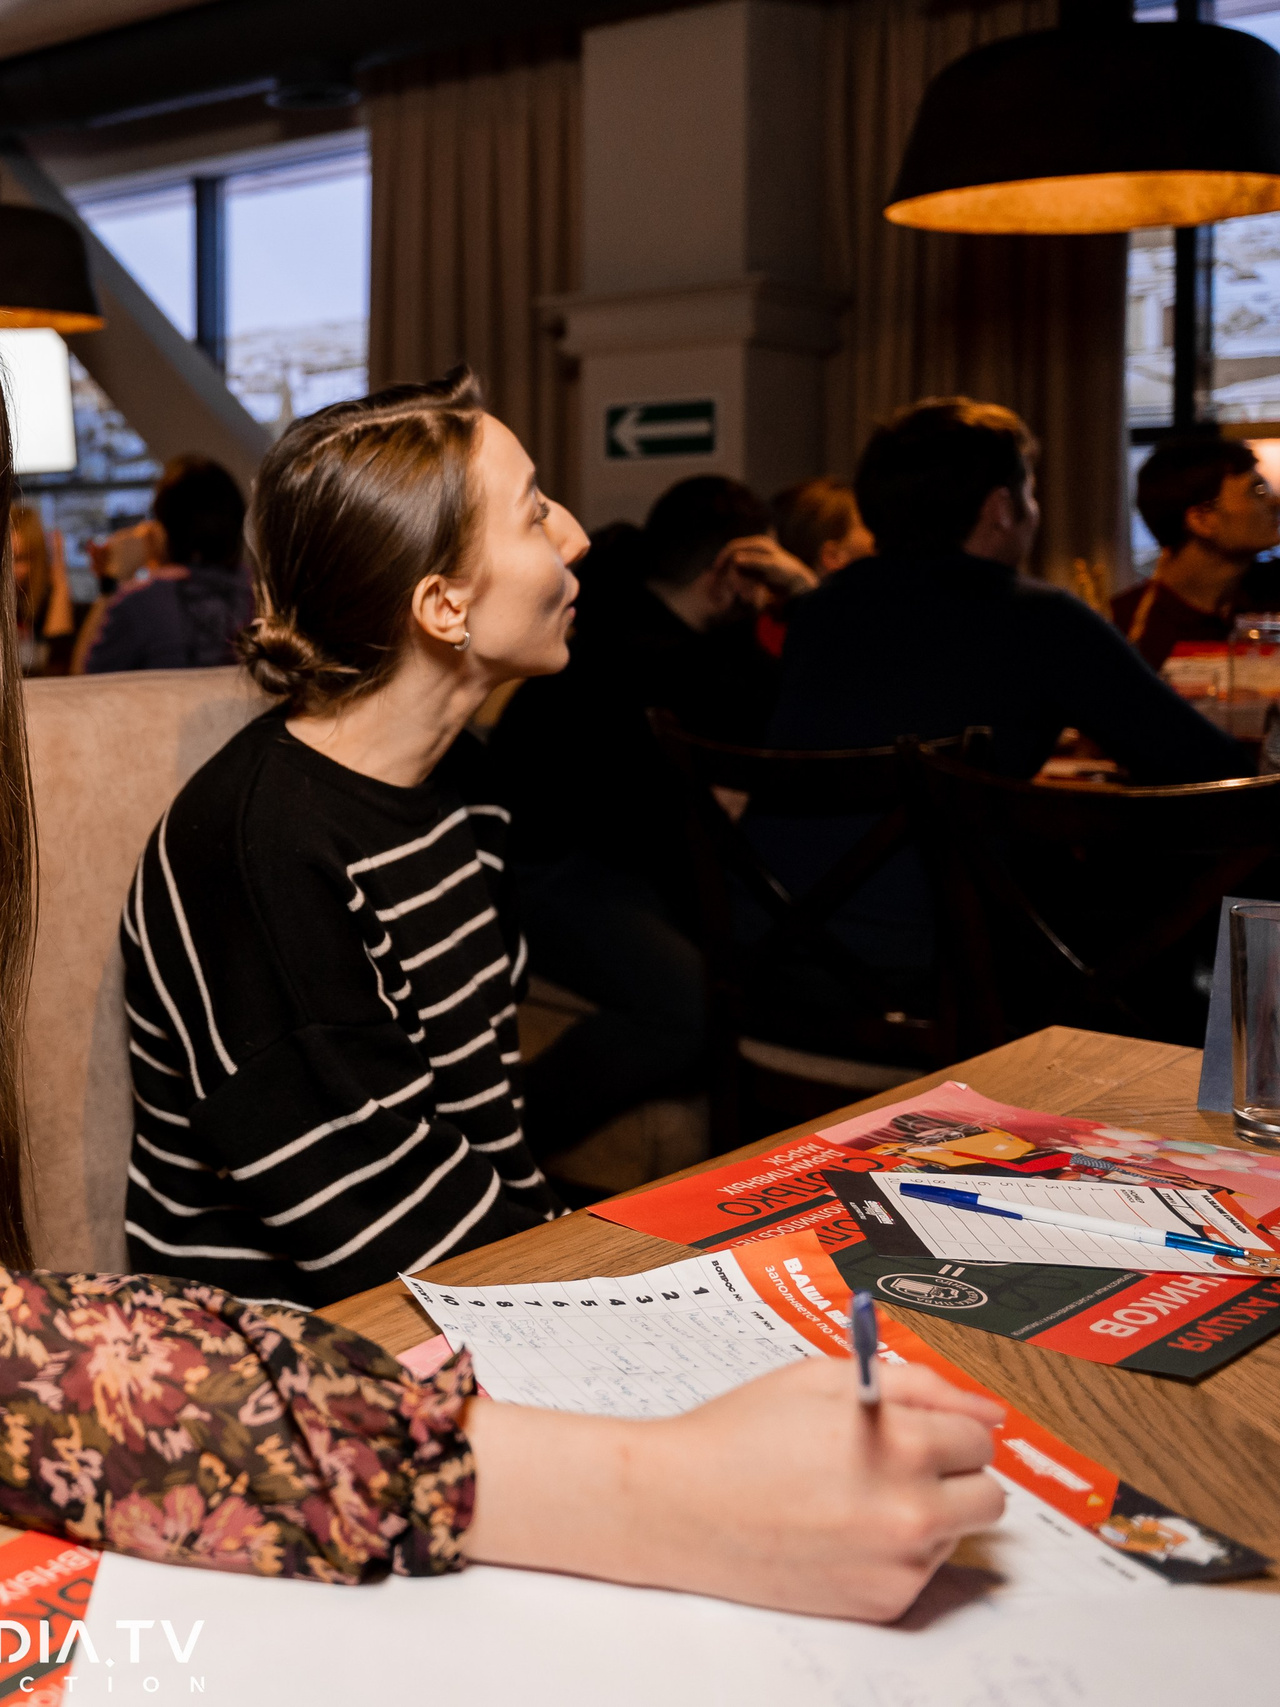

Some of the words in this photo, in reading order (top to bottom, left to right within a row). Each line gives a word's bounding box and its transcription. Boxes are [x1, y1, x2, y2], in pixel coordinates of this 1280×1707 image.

[763, 1142, 825, 1166] МАРОК
[787, 1148, 846, 1174] ДАРИМ
[716, 1168, 793, 1196] ПИВНЫХ
[717, 1157, 884, 1216] СОЛЬКО
[711, 1260, 736, 1293] ВОПРОС
[783, 1257, 832, 1311] ВАША
[439, 1293, 460, 1306] 10
[636, 1295, 653, 1304] 3
[661, 1291, 680, 1301] 2
[692, 1286, 710, 1296] 1
[496, 1300, 514, 1308] 8
[580, 1299, 599, 1307] 5
[608, 1298, 626, 1306] 4
[1089, 1274, 1228, 1338] НИКОВ
[817, 1322, 833, 1334] по
[1167, 1296, 1279, 1352] АКЦИЯ
